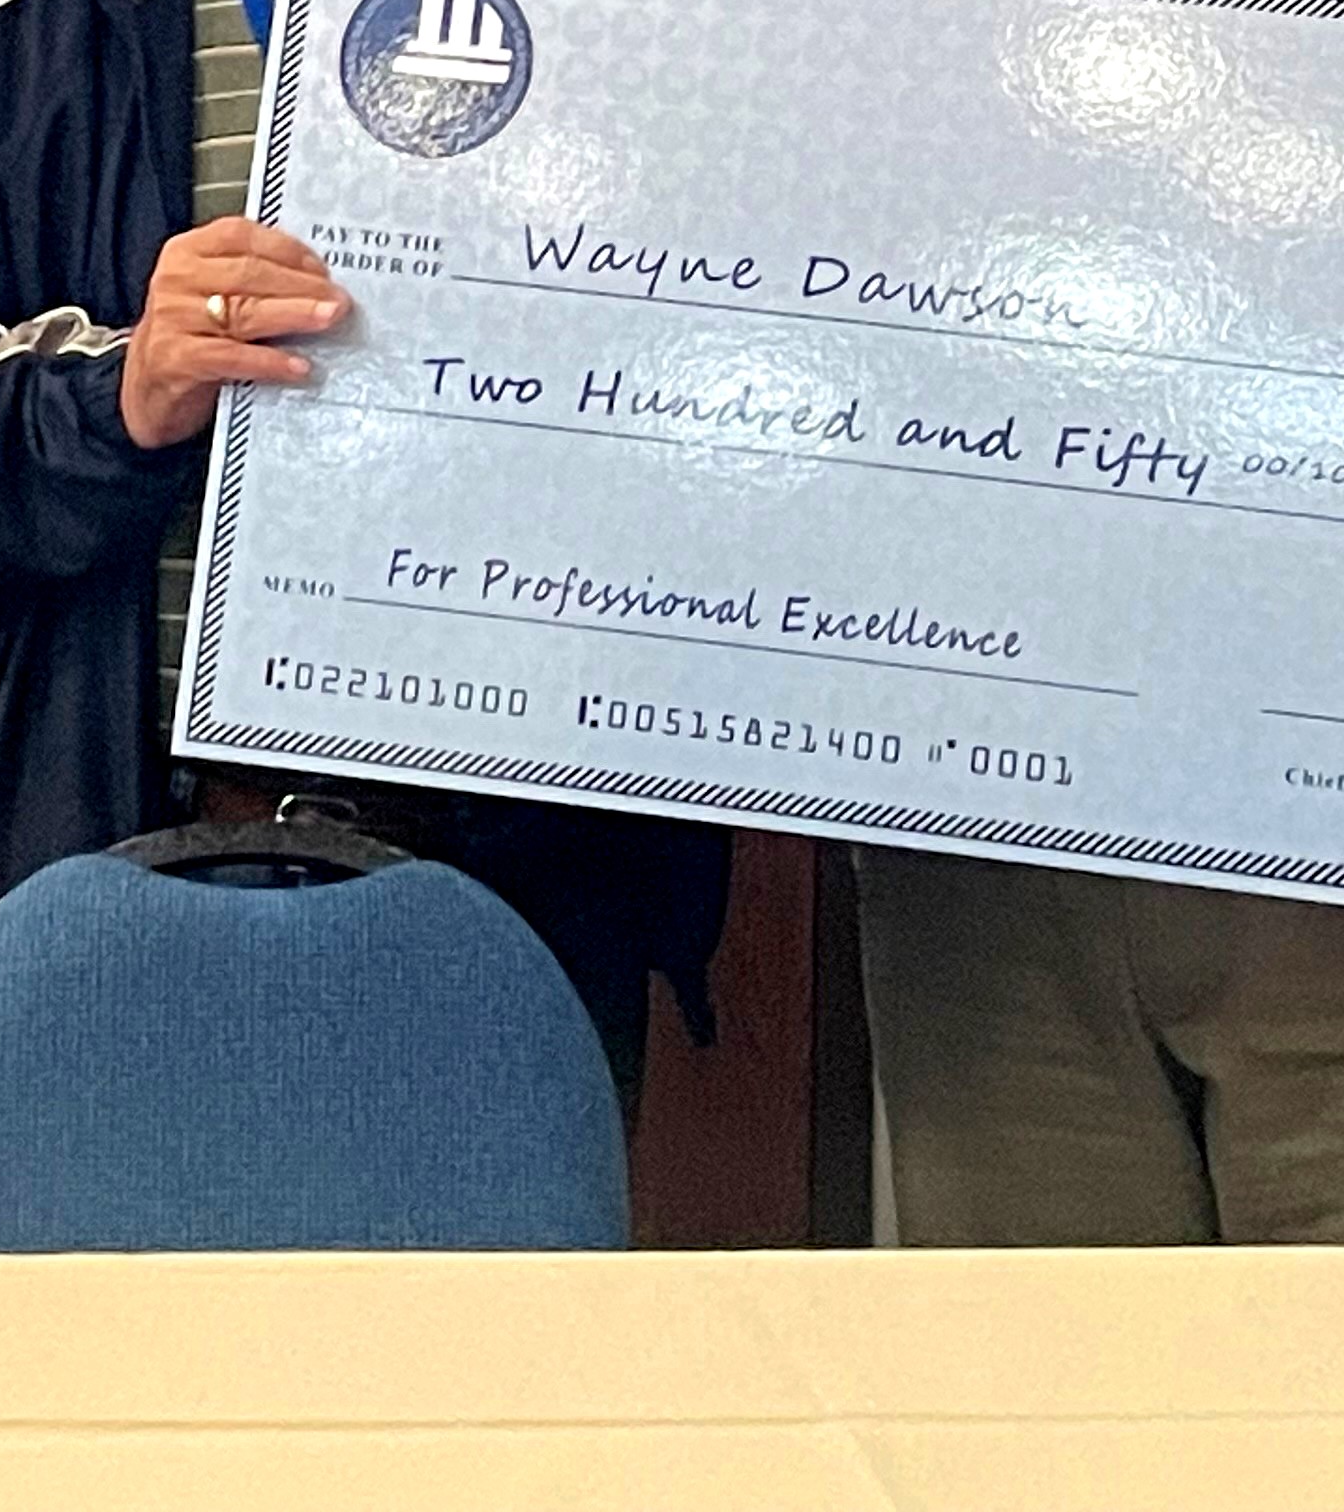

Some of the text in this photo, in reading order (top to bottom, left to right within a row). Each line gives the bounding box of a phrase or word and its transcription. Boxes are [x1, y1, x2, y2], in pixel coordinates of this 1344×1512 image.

[311, 223, 445, 253] PAY TO THE
[323, 250, 446, 278] ORDER OF
[524, 221, 1087, 329] Wayne Dawson
[422, 356, 544, 405] Two
[577, 369, 866, 444] Hundred
[895, 414, 1024, 462] and
[1055, 426, 1211, 497] Fifty
[262, 547, 1023, 658] MEMO For Professional Excellence
